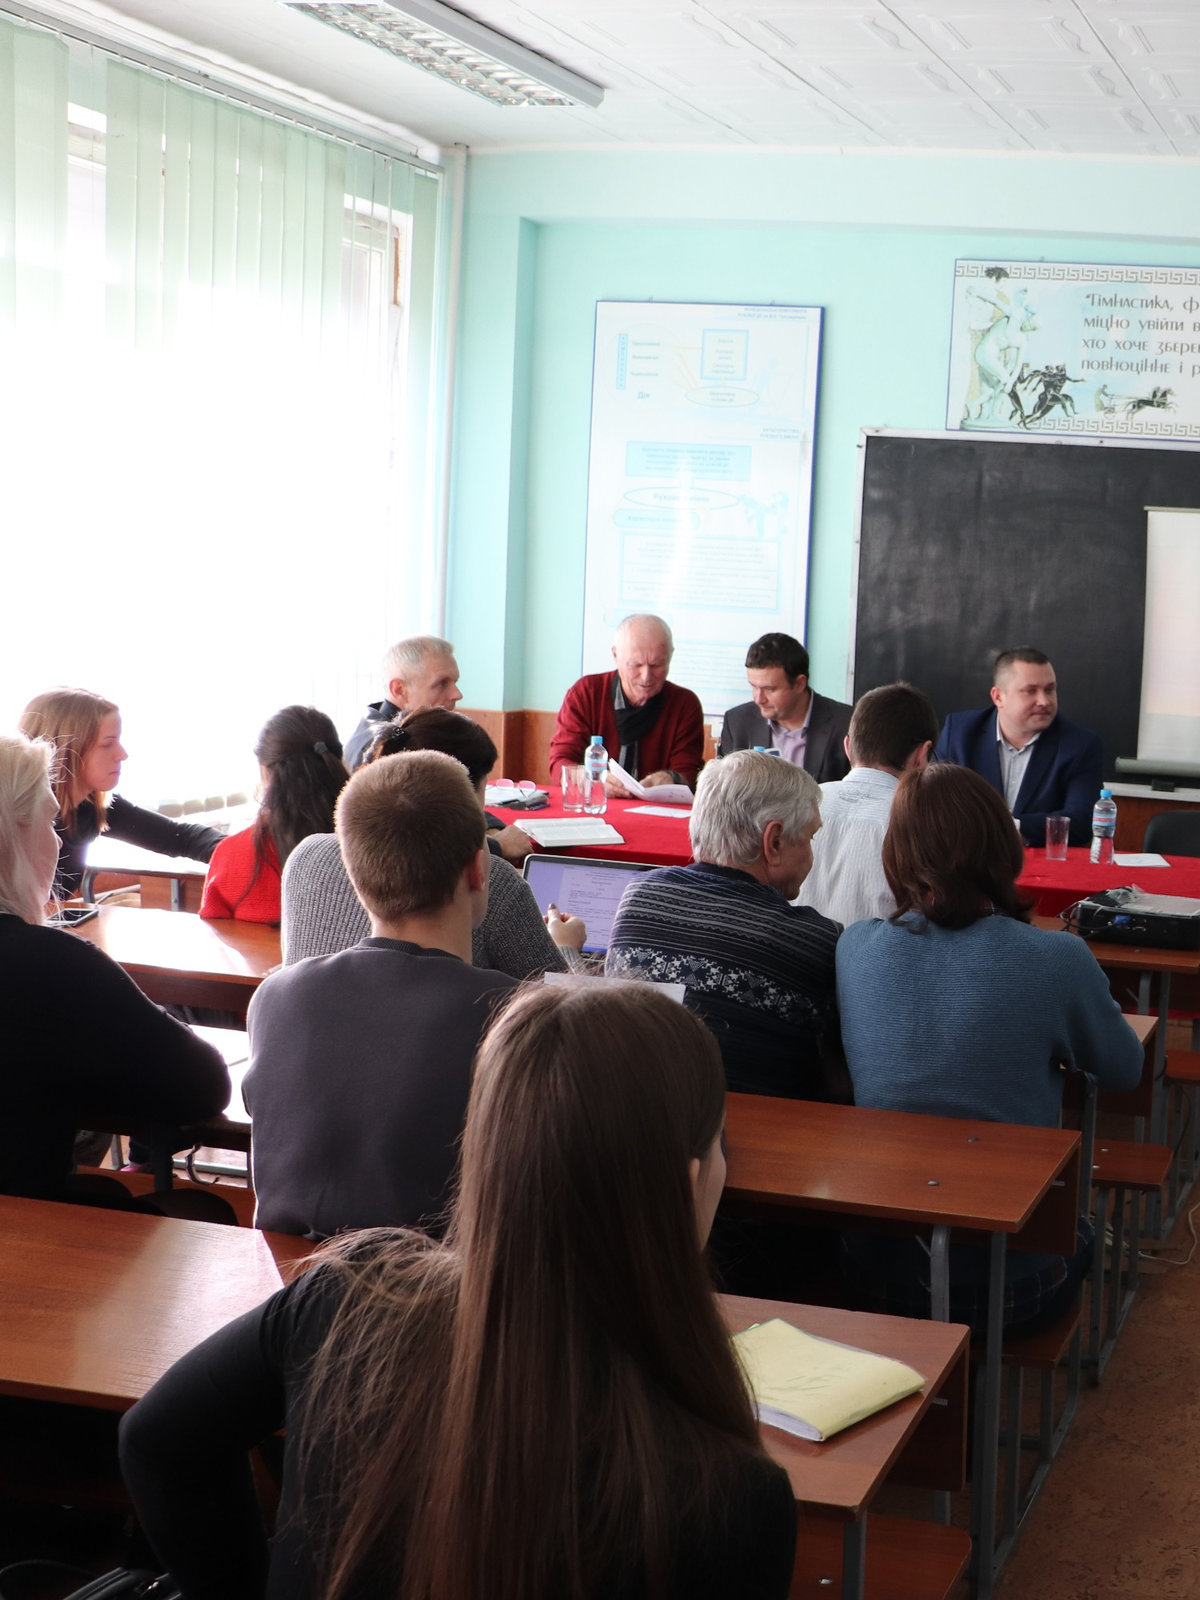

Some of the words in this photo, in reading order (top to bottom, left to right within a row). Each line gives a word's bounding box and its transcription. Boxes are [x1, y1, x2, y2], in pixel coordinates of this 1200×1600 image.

[1083, 314, 1130, 331] міцно
[1138, 317, 1184, 333] увійти
[1082, 338, 1106, 349] хто
[1114, 339, 1148, 351] хоче
[1081, 356, 1170, 375] повноцінне
[1179, 361, 1184, 373] і
